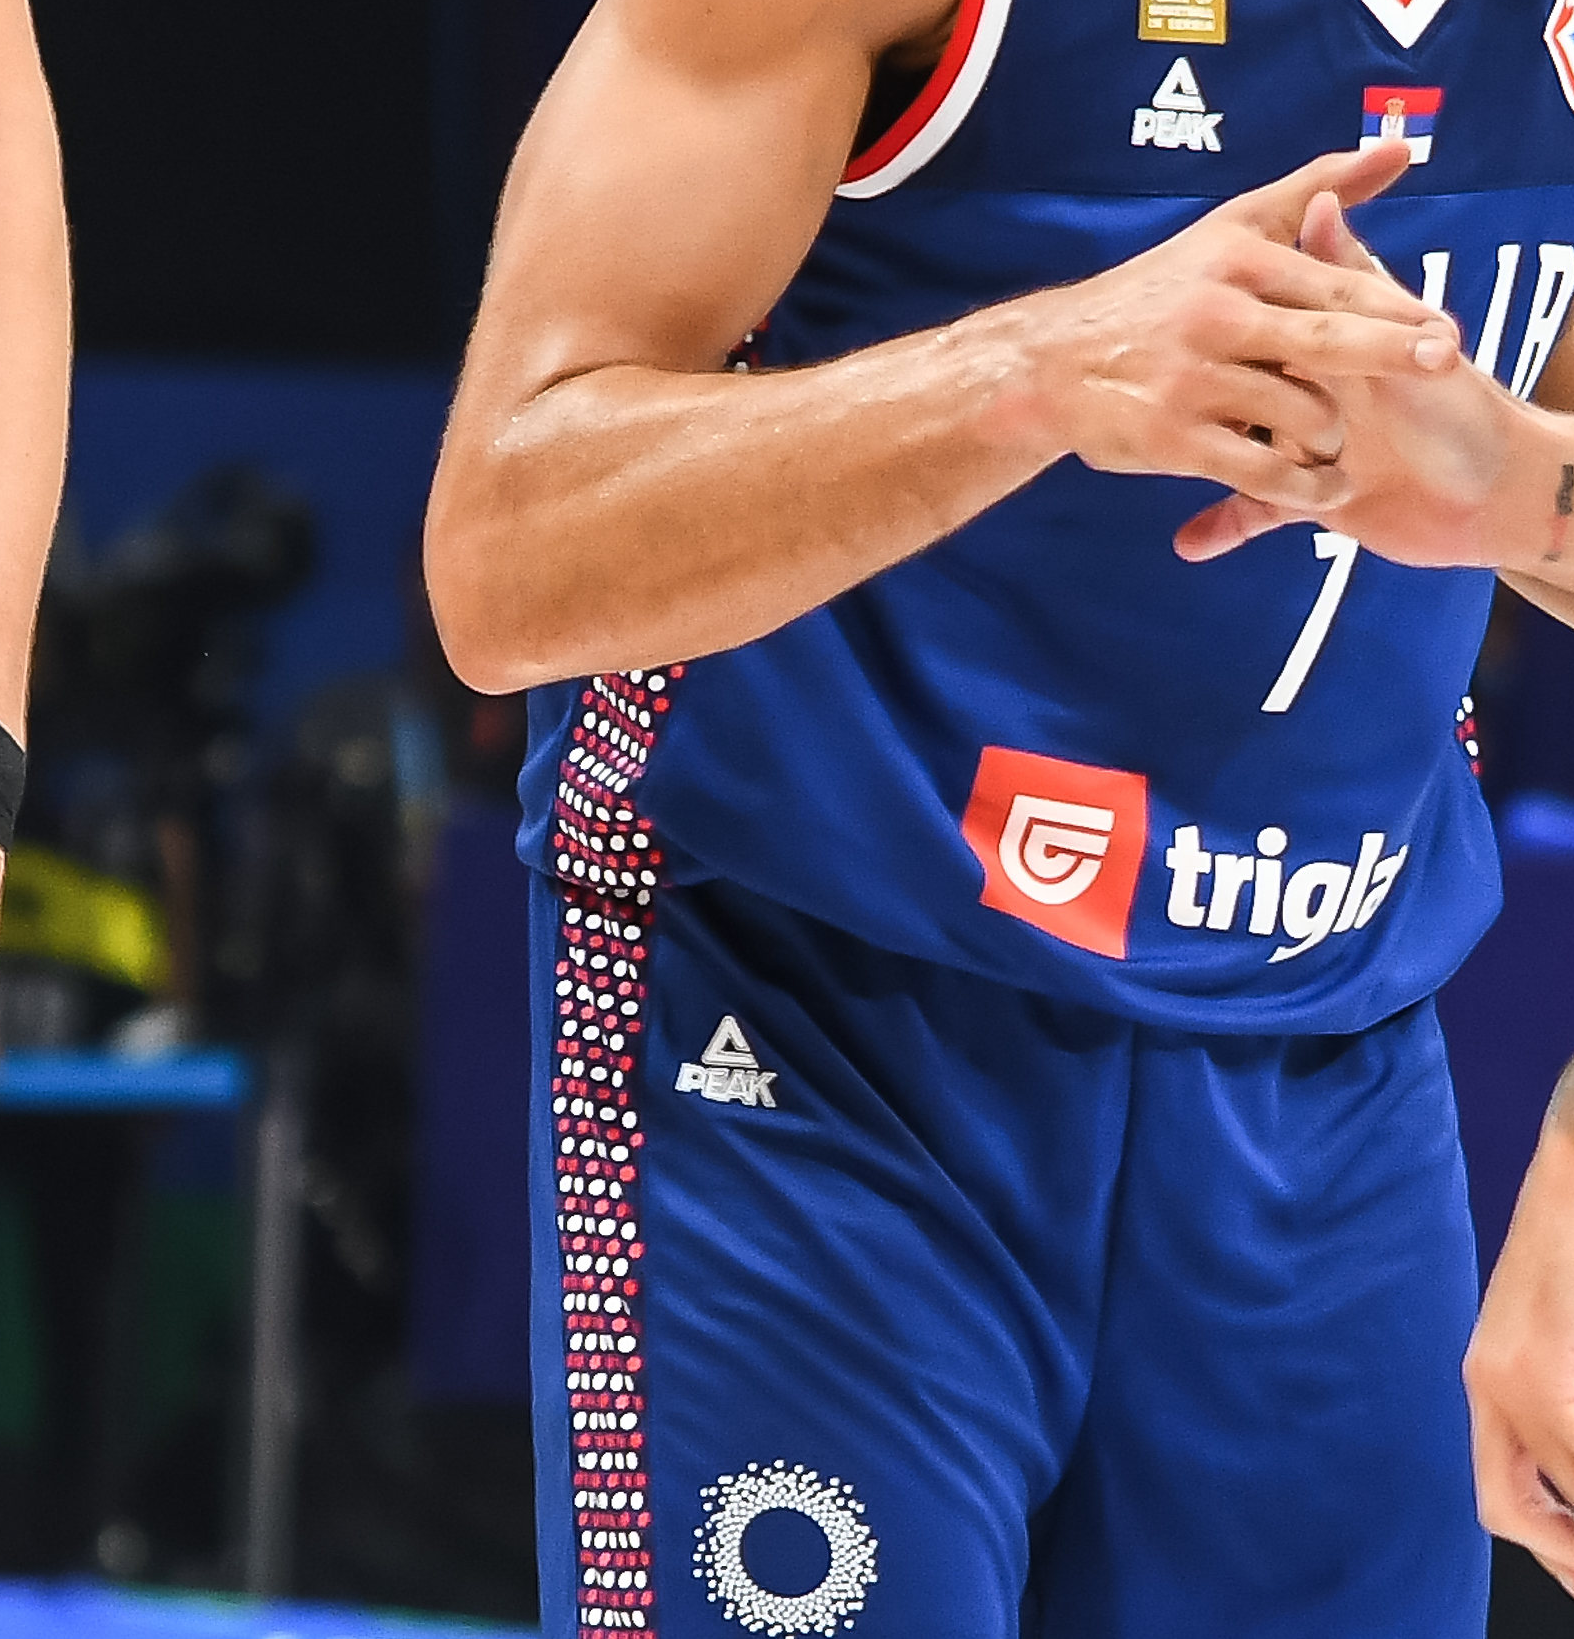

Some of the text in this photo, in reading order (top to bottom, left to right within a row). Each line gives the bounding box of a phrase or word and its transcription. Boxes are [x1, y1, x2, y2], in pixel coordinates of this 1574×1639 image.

[1130, 107, 1224, 152] PEAK
[1261, 530, 1360, 713] 7
[1165, 825, 1410, 964] trigla
[675, 1063, 779, 1109] PEAK
